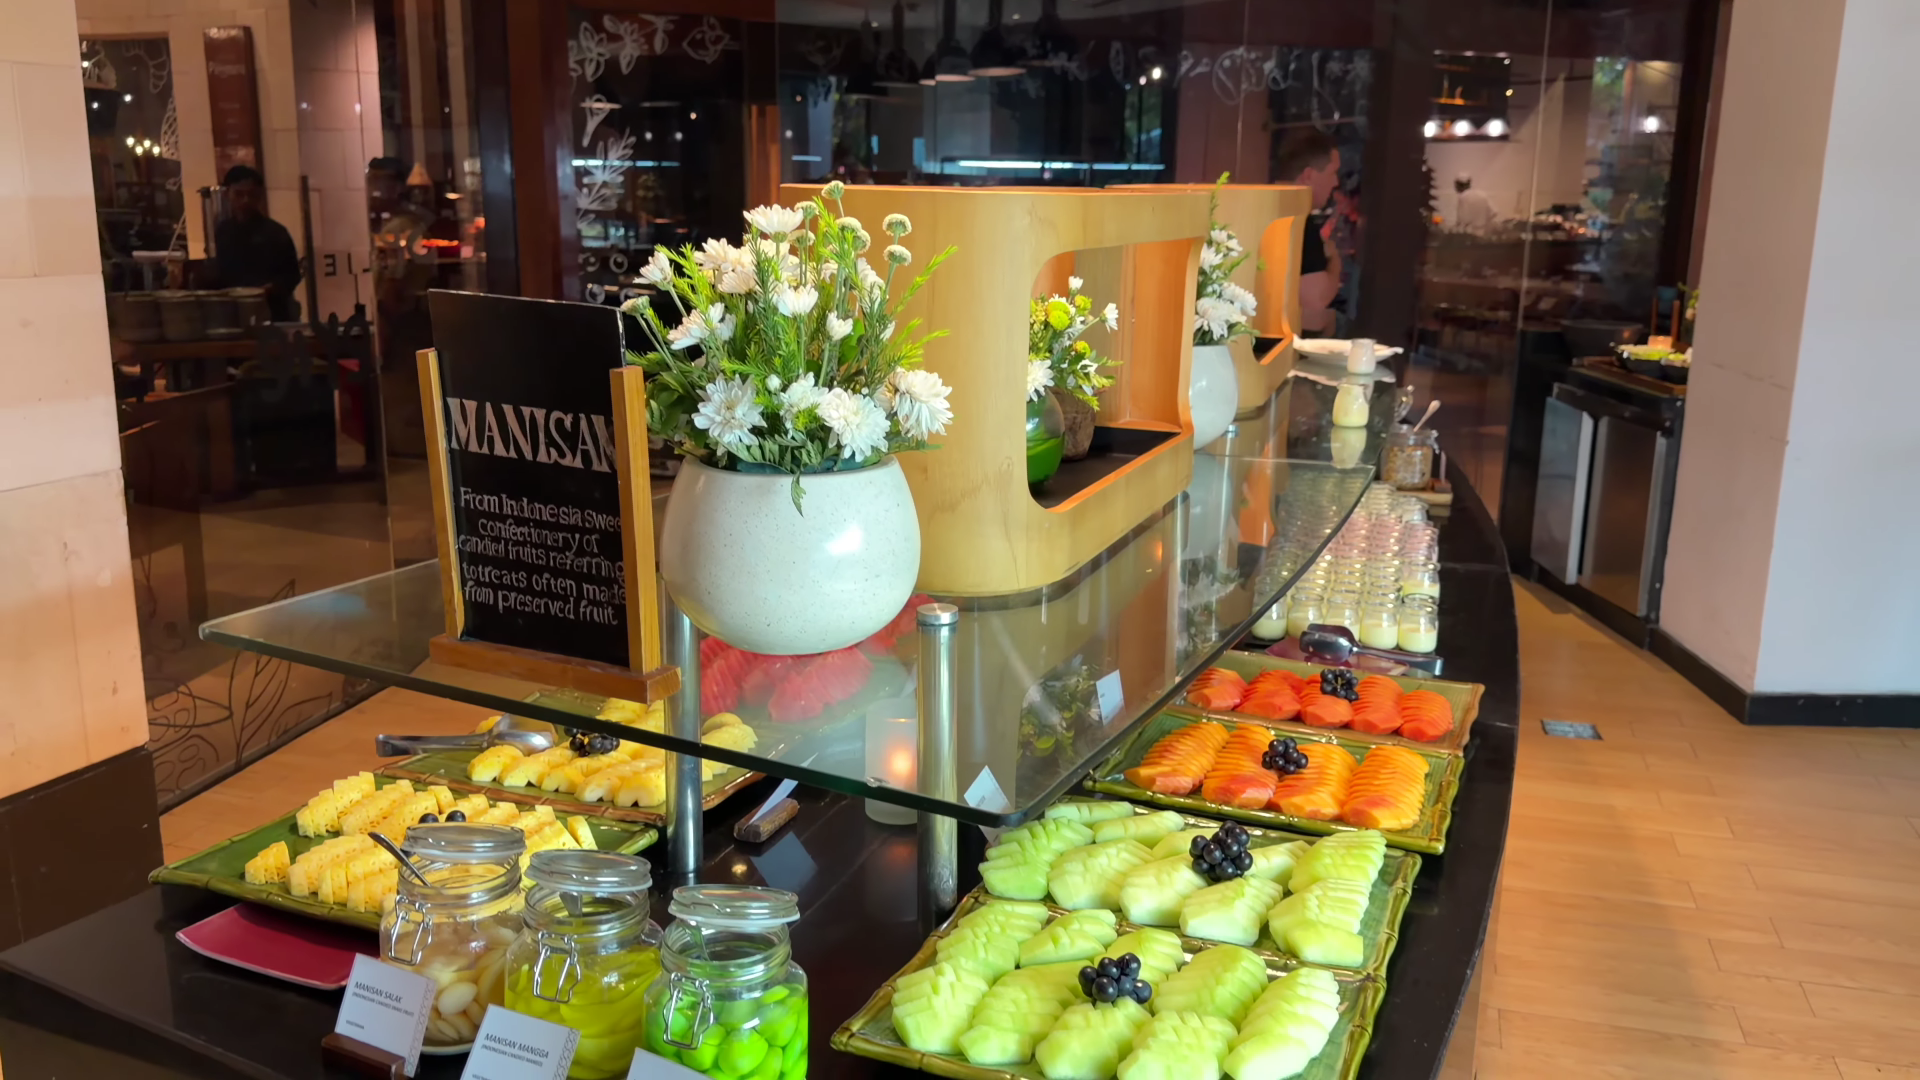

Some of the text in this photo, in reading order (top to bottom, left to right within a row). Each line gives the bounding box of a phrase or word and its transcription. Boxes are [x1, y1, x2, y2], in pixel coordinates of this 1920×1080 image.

[460, 487, 499, 513] From
[501, 493, 582, 527] Indonesia
[479, 518, 580, 556] confectionery
[459, 534, 625, 587] candied fruits referring
[464, 580, 618, 625] from preserved fruit
[532, 572, 576, 598] often
[583, 582, 626, 604] made
[354, 981, 403, 1004] MANISAN SALAK
[484, 1033, 549, 1059] MANISAN MANGGA
